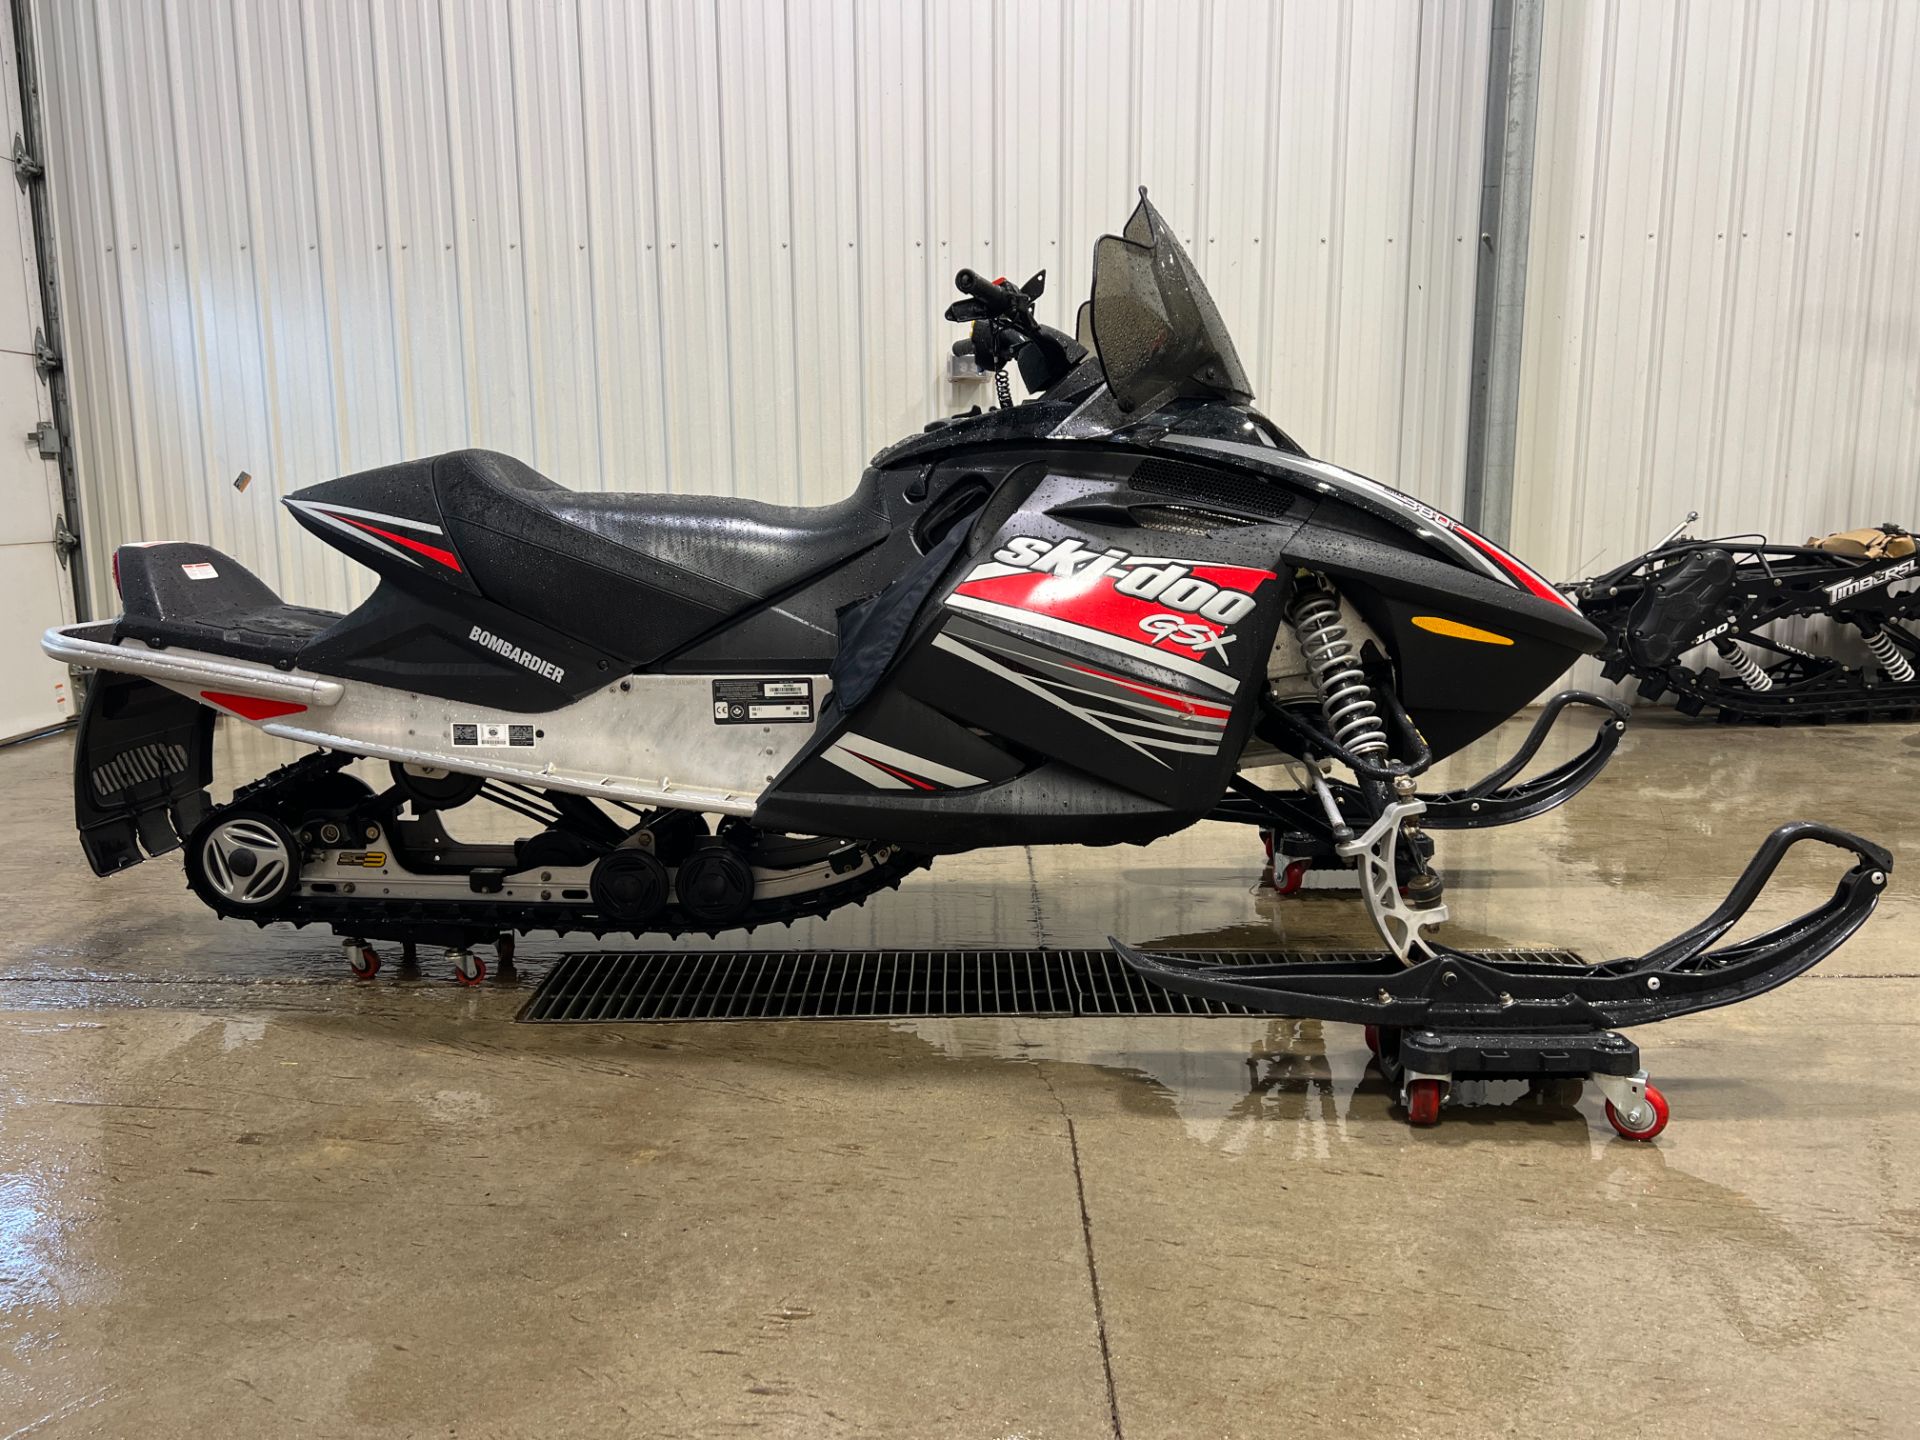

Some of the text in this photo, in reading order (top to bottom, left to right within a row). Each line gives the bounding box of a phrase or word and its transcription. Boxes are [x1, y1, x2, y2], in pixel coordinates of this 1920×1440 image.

[468, 625, 565, 684] BOMBARDIER
[1138, 613, 1237, 667] GSX
[1695, 622, 1729, 645] 120
